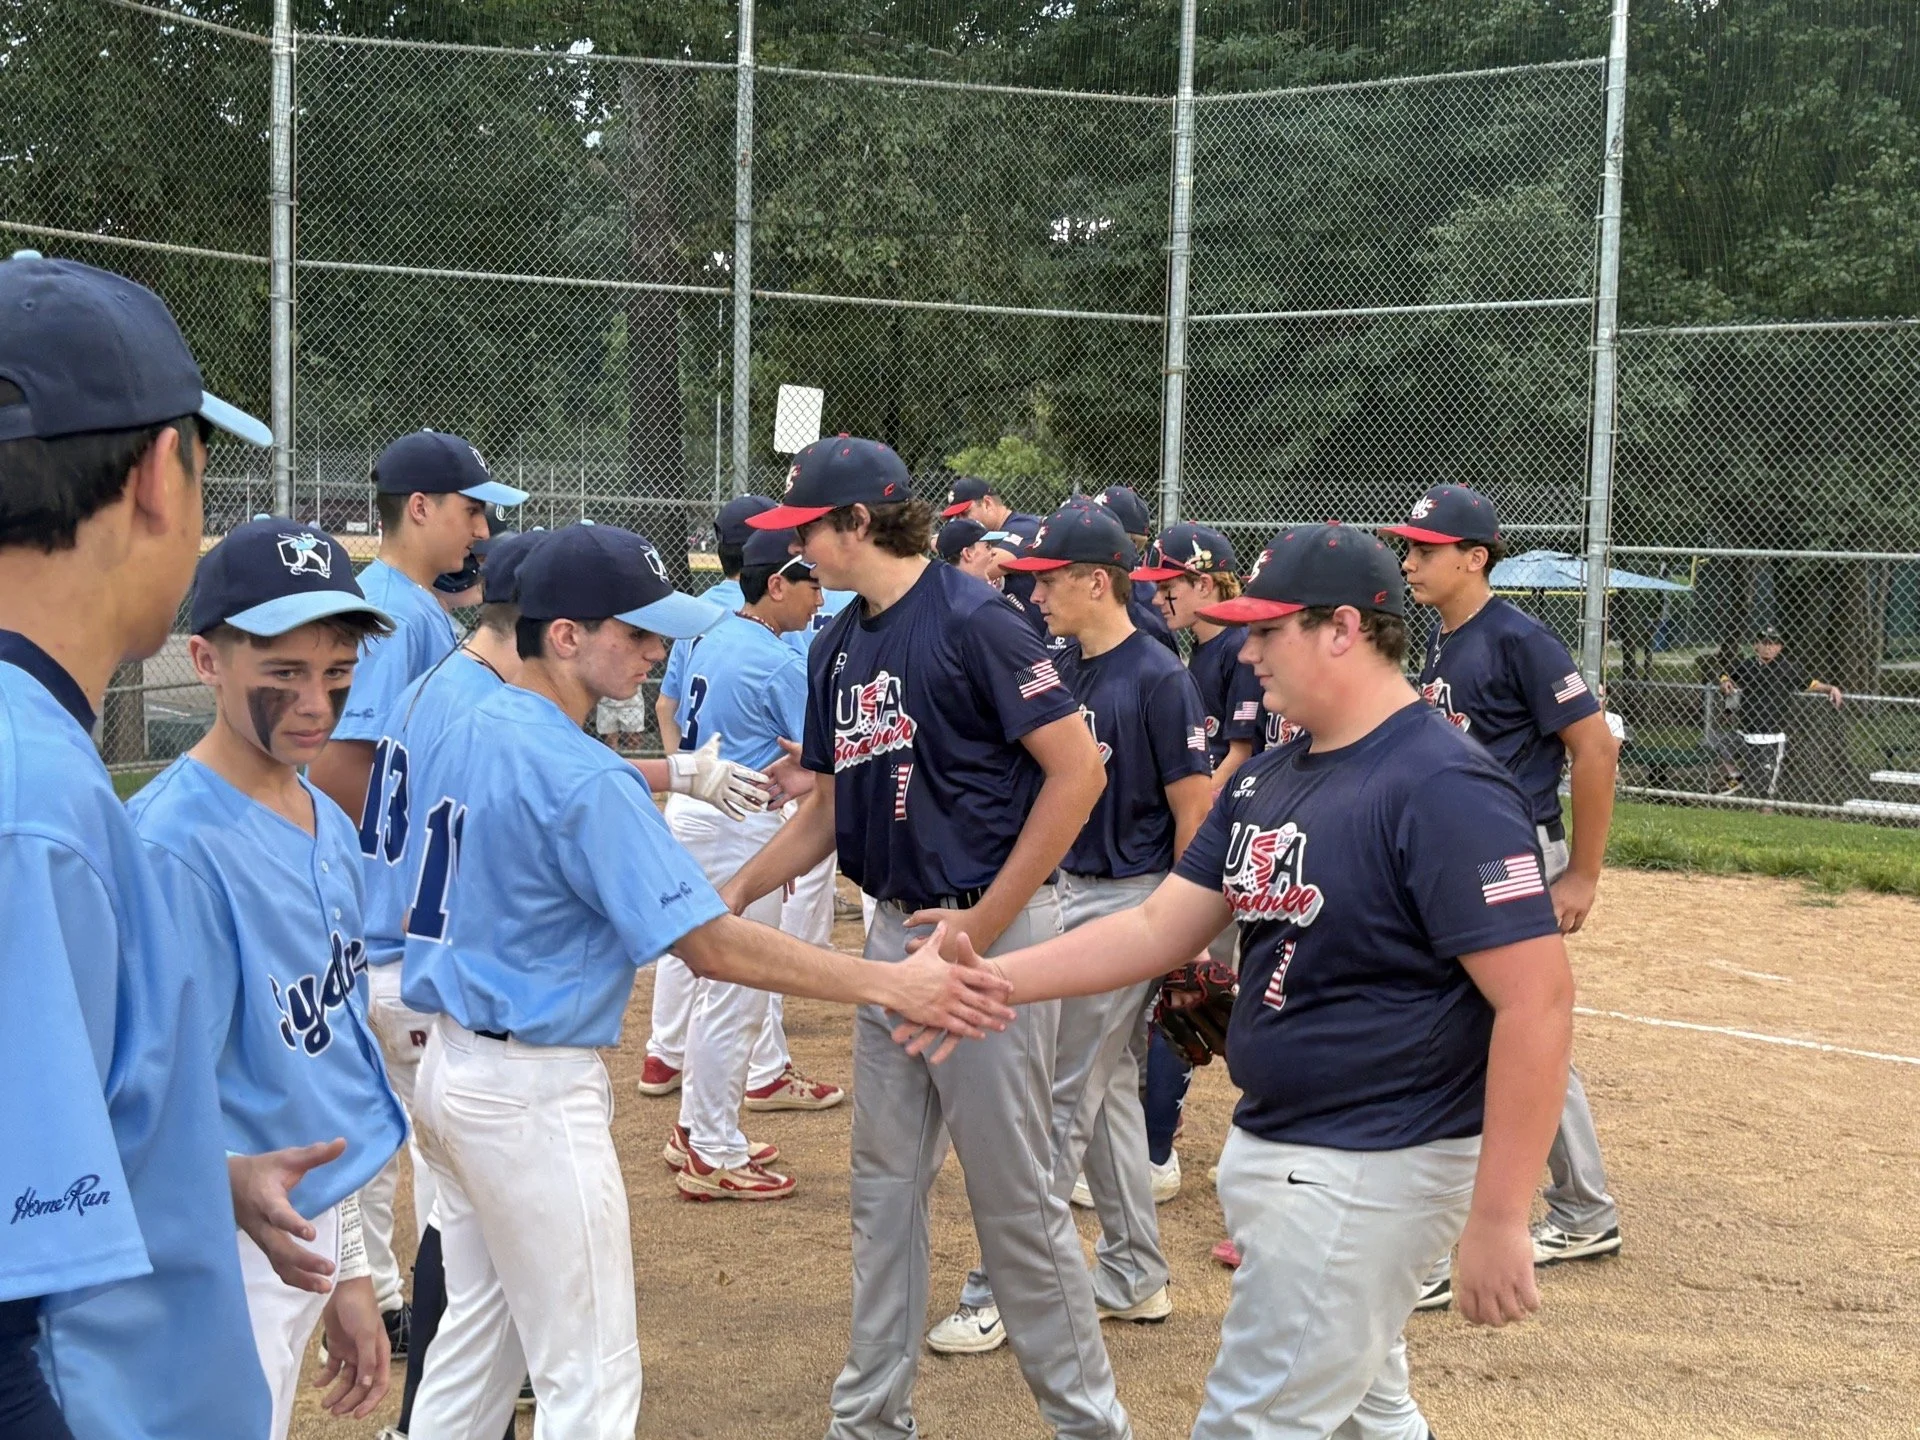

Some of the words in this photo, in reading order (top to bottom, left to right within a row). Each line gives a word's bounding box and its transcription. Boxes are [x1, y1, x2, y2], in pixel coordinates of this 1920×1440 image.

[834, 671, 902, 737] USA
[1223, 822, 1307, 893] USA
[9, 1186, 65, 1225] Home
[64, 1173, 111, 1217] Run
